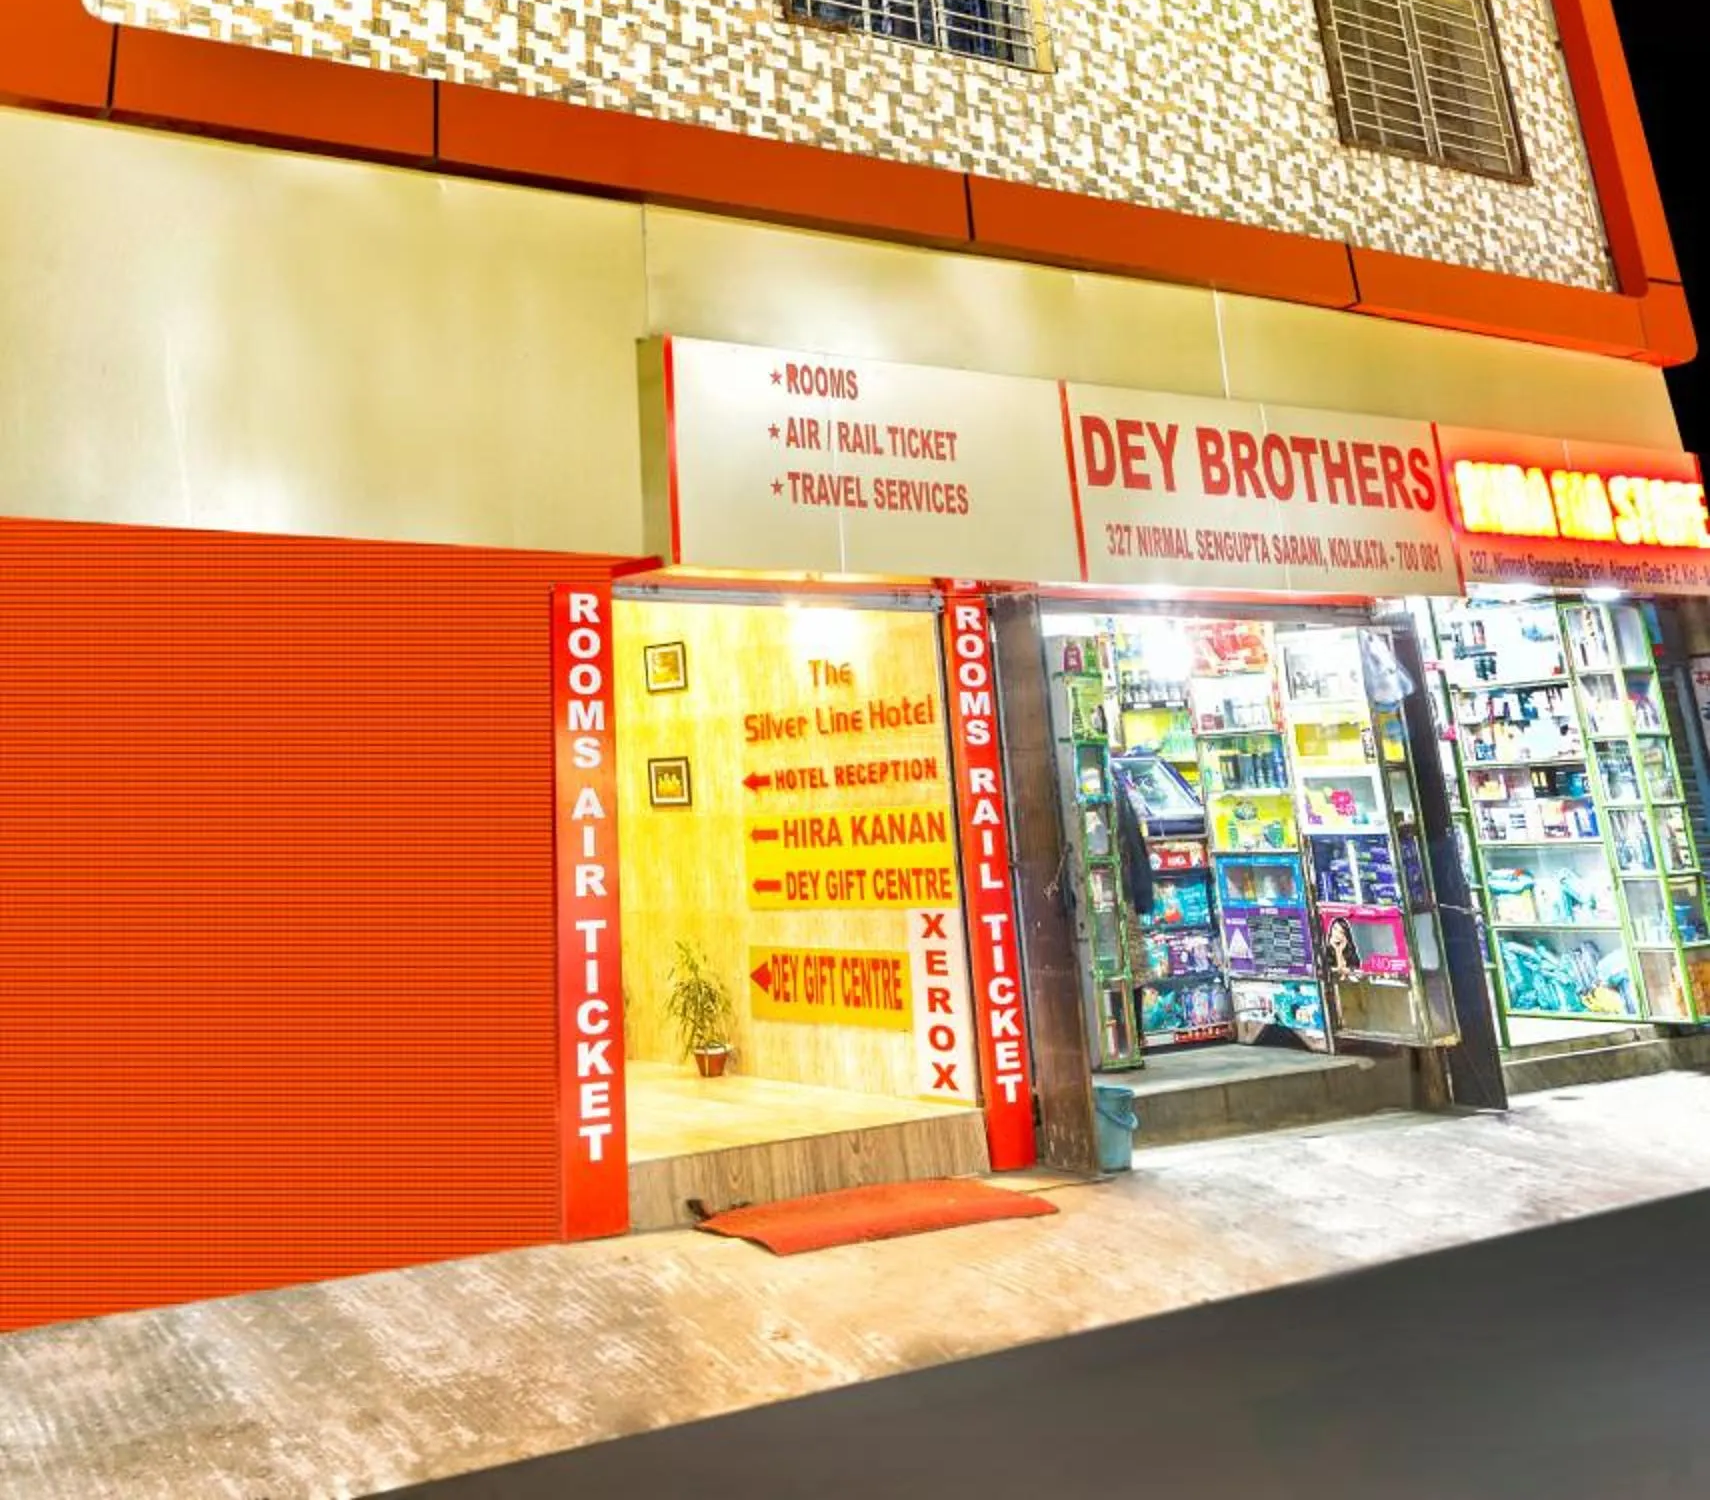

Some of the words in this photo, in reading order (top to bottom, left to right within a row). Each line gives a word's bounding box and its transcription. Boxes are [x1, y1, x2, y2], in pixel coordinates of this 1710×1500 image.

[785, 363, 858, 400] ROOMS
[785, 417, 821, 450] AIR
[837, 421, 883, 456] RAIL
[888, 427, 958, 461] TICKET
[1080, 415, 1179, 492] DEY
[1195, 426, 1436, 512] BROTHERS
[787, 472, 868, 509] TRAVEL
[873, 478, 969, 515] SERVICES
[1105, 523, 1132, 557] 327
[1137, 525, 1194, 560] NIRMAL
[1195, 529, 1270, 565] SENGUPTA
[1328, 537, 1389, 570] KOLKATA
[567, 592, 605, 769] ROOMS
[807, 658, 853, 689] The
[955, 605, 991, 746] ROOMS
[743, 712, 809, 744] Silver
[814, 705, 864, 737] Line
[868, 693, 936, 731] Hotel
[774, 766, 830, 791] HOTEL
[833, 756, 938, 787] RECEPTION
[571, 787, 608, 898] AIR
[782, 817, 844, 850] HIRA
[849, 811, 946, 846] KANAN
[968, 767, 1005, 890] RAIL
[786, 869, 820, 902] DEY
[825, 869, 866, 901] GIFT
[871, 867, 953, 902] CENTRE
[771, 953, 799, 1003] DEY
[803, 956, 838, 1007] GIFT
[840, 958, 905, 1012] CENTRE
[921, 913, 960, 1092] XEROX
[982, 913, 1024, 1104] TICKET
[575, 918, 613, 1163] TICKET
